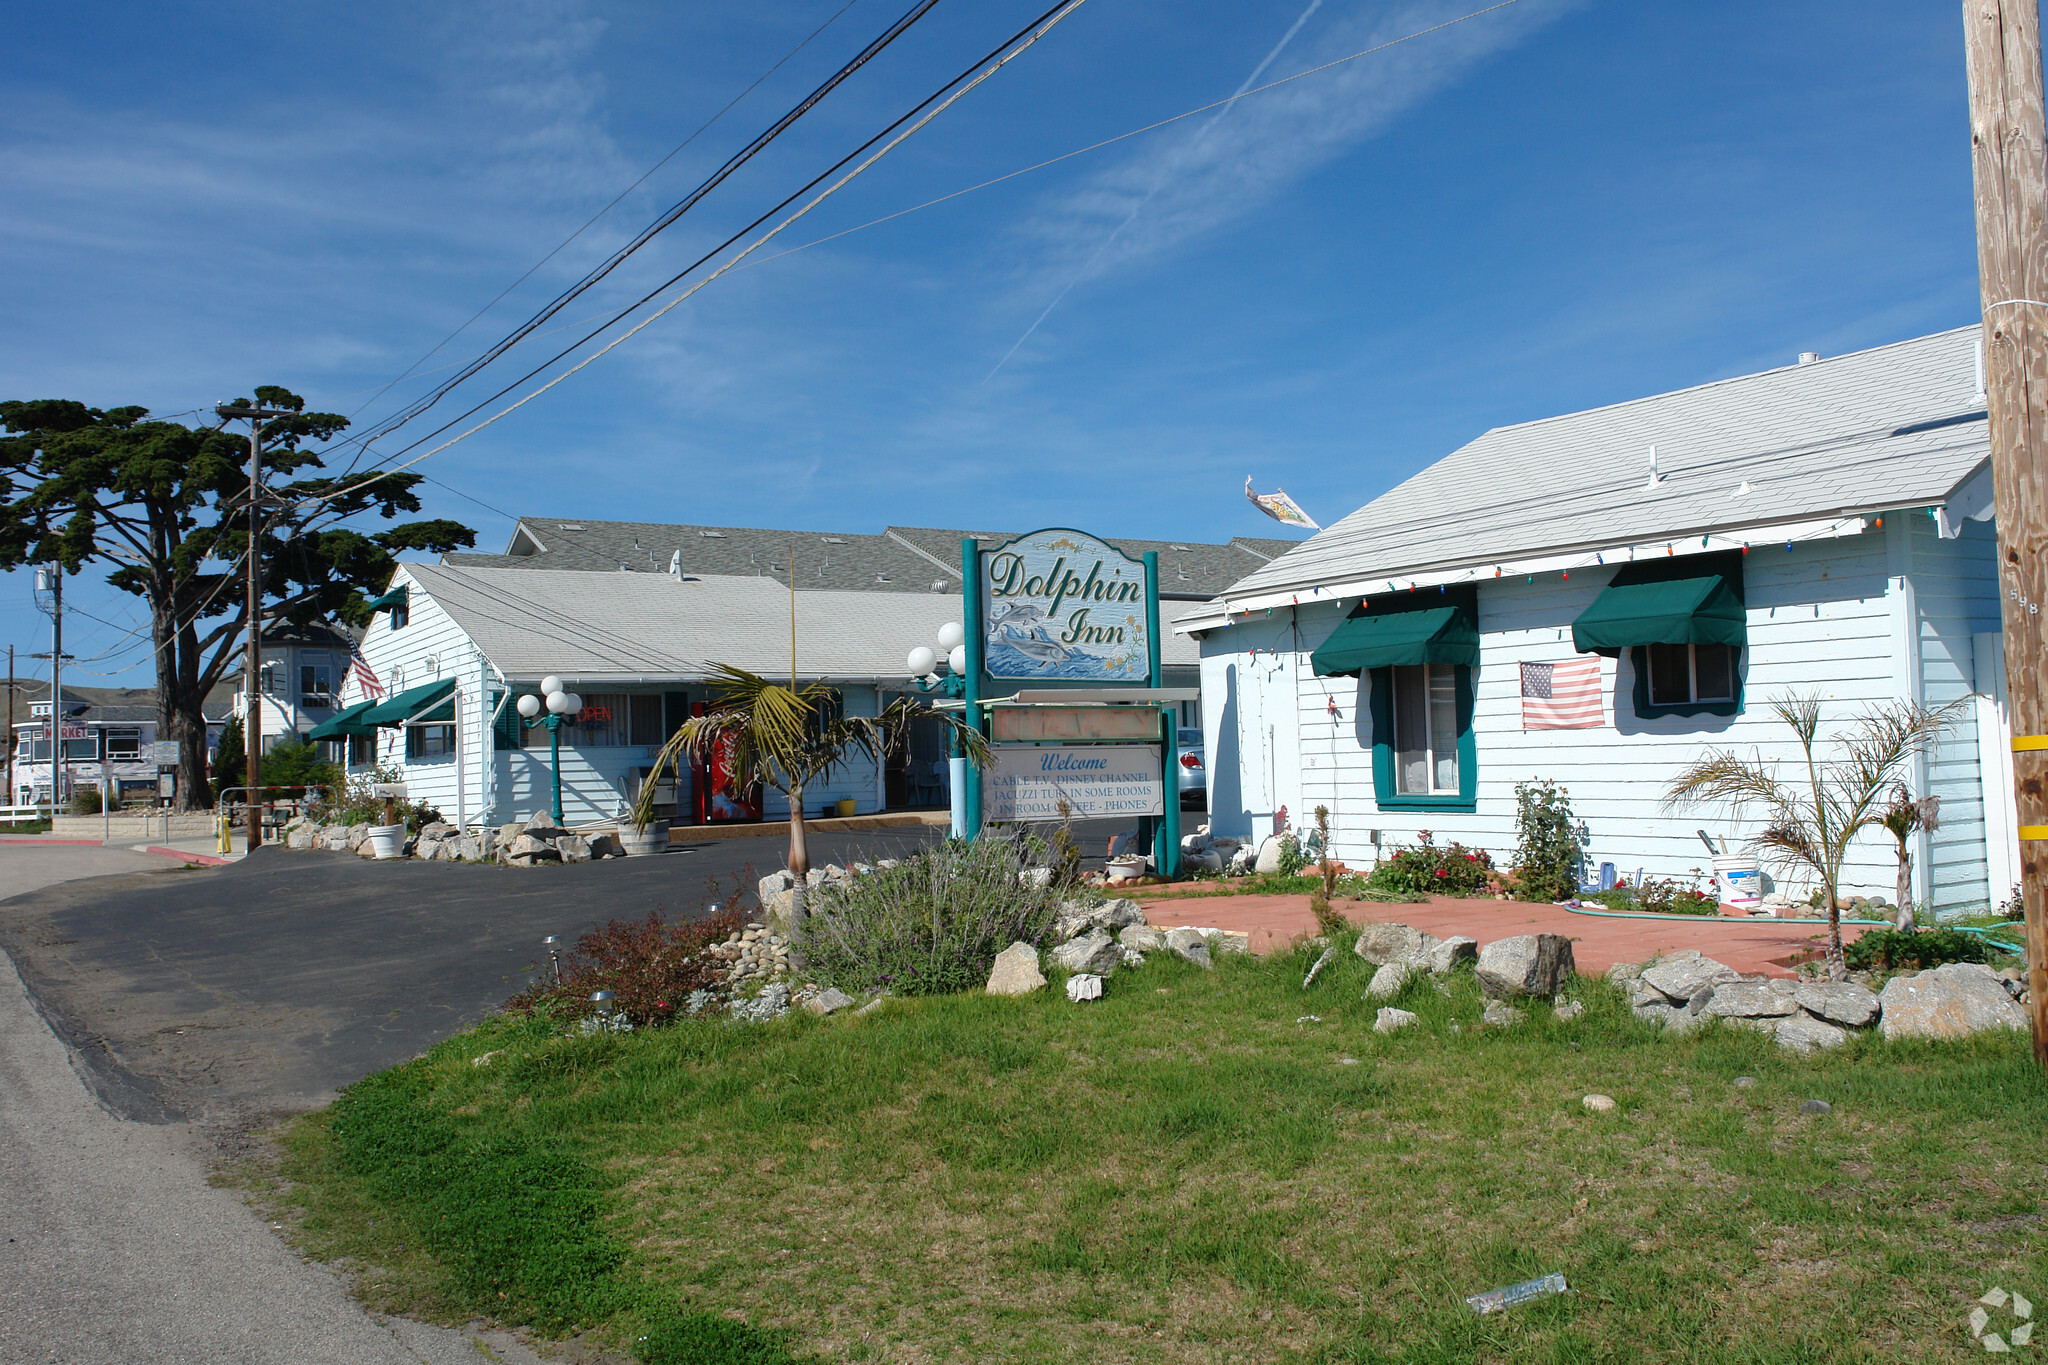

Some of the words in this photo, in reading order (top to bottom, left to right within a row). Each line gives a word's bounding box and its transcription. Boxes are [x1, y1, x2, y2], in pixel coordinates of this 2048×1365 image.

[989, 551, 1141, 618] Dolphin
[1060, 607, 1126, 645] Inn
[576, 705, 611, 722] OPEN
[45, 727, 87, 739] MRKET
[993, 710, 1019, 739] NO
[1027, 710, 1151, 738] VACANCY
[1040, 753, 1108, 771] Welcome
[992, 774, 1031, 787] CABLE
[1056, 773, 1096, 785] DISNEY
[1099, 772, 1150, 784] CHANNEL
[993, 788, 1038, 802] JACUZZI
[1070, 786, 1082, 798] IN
[1084, 785, 1114, 798] SOME
[1116, 784, 1152, 796] ROOMS
[999, 803, 1012, 815] IN
[1016, 802, 1051, 814] ROOM
[1053, 800, 1096, 813] CFFEE
[1105, 799, 1148, 812] PHONES
